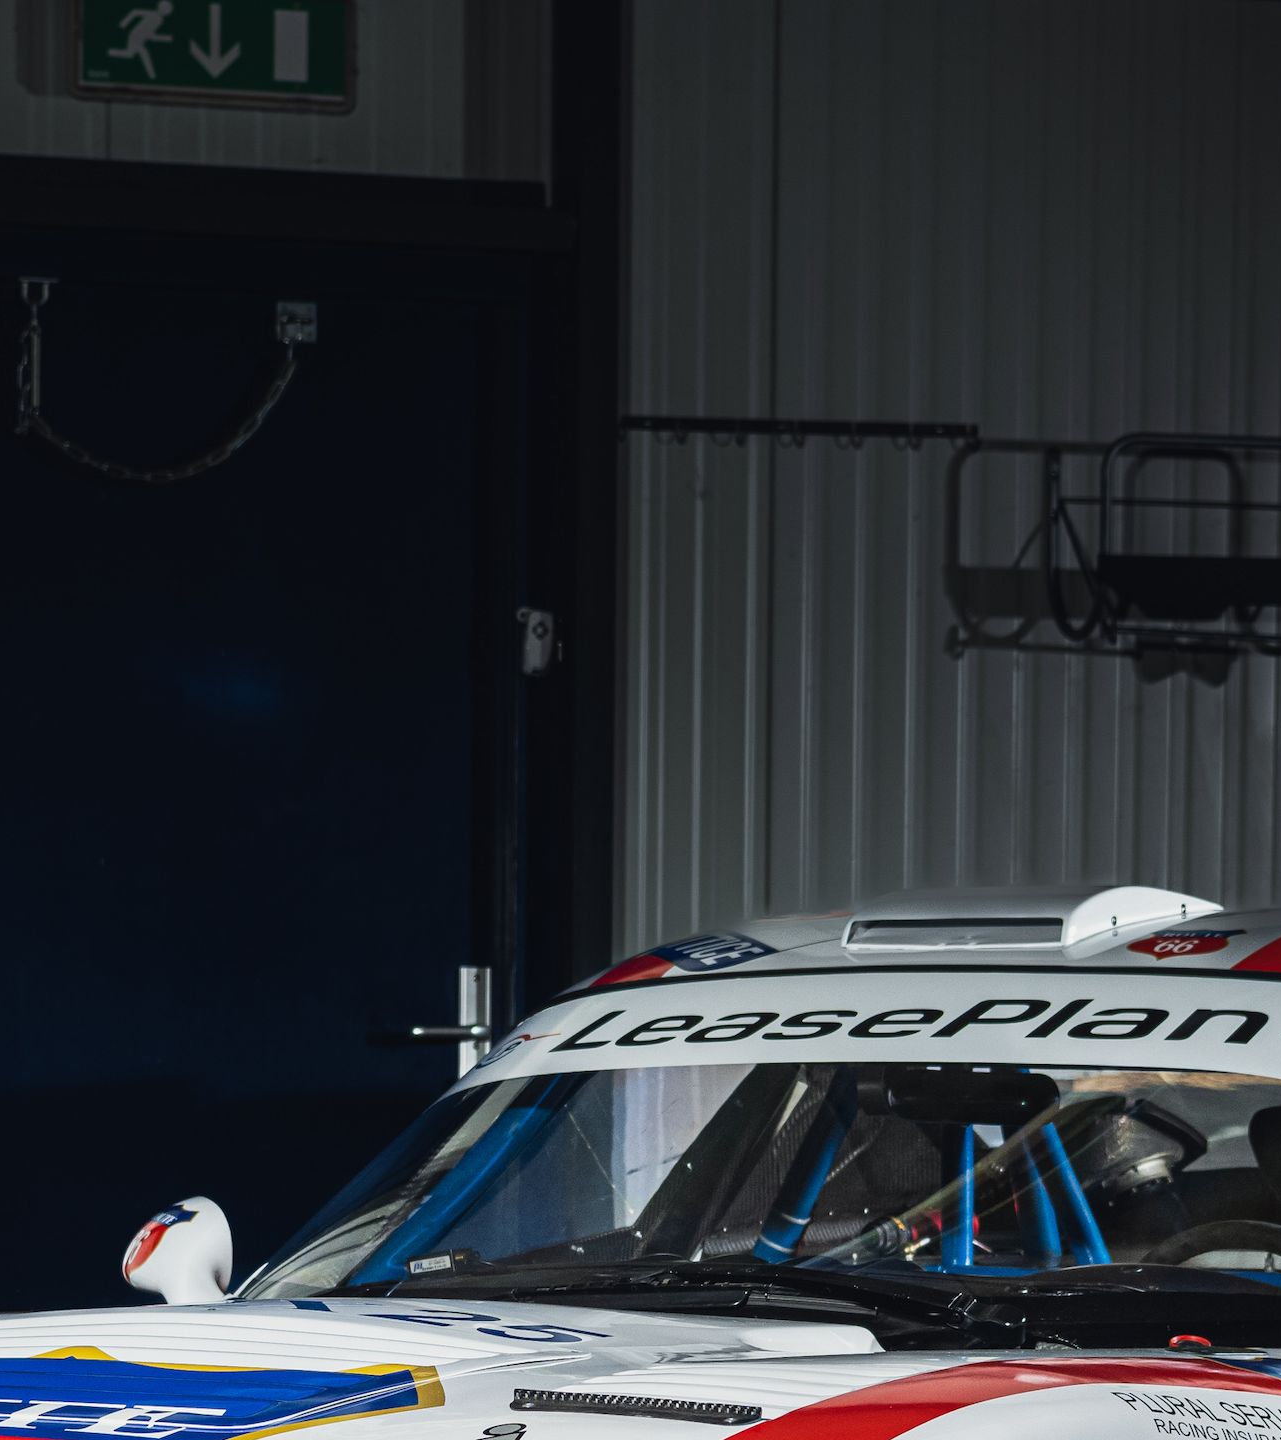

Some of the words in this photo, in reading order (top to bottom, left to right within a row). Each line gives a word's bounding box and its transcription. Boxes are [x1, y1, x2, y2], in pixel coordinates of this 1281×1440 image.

[1152, 937, 1195, 955] 66
[549, 997, 1271, 1053] LeasePlan
[1113, 1391, 1226, 1428] PLURAL
[1155, 1418, 1220, 1440] RACING
